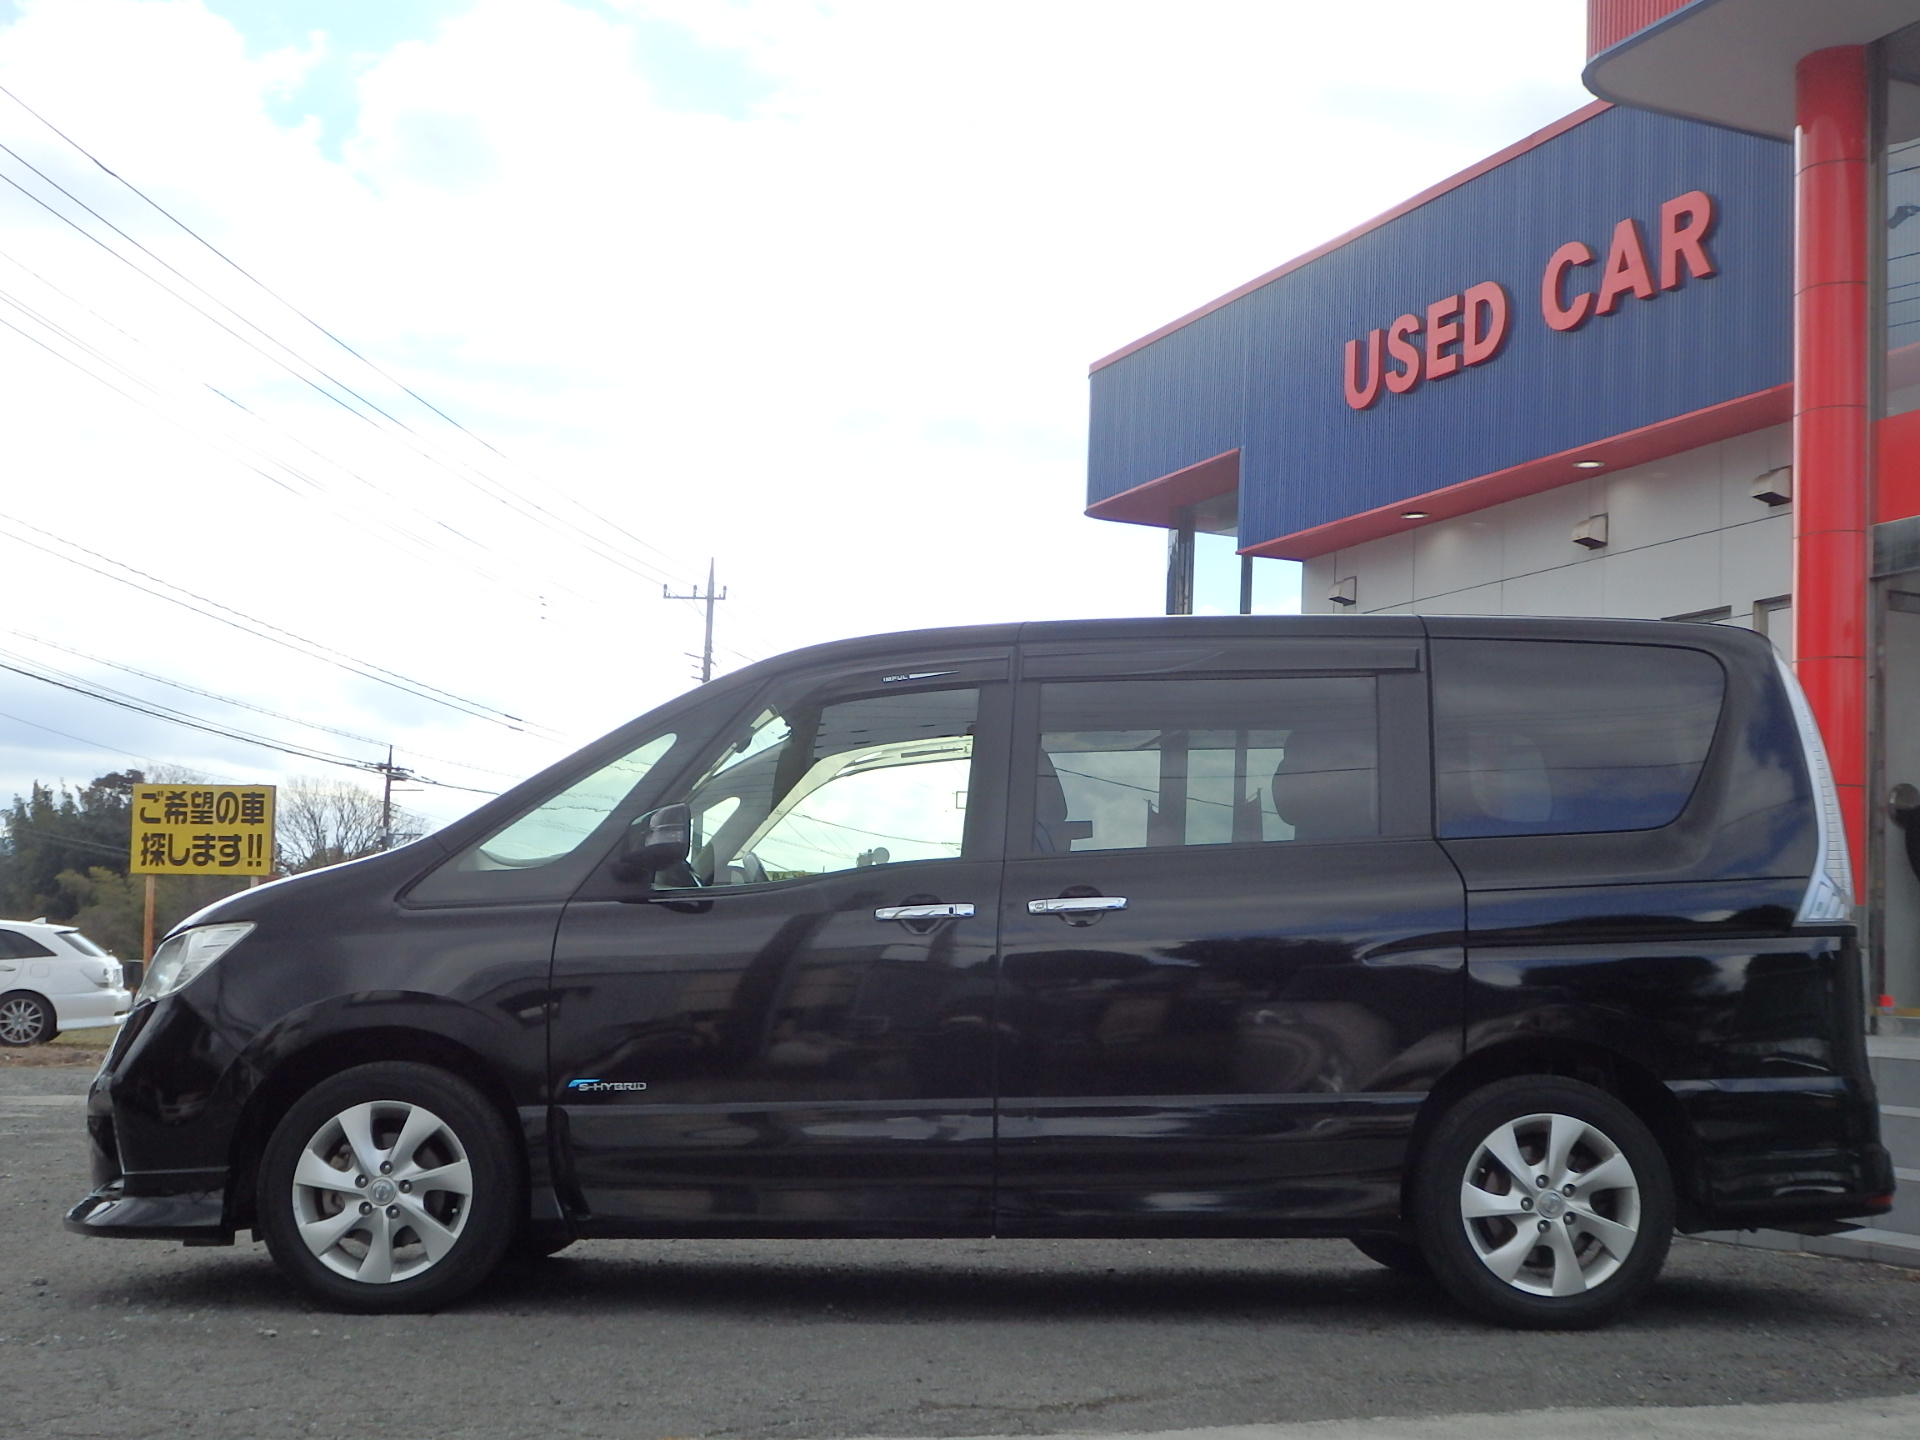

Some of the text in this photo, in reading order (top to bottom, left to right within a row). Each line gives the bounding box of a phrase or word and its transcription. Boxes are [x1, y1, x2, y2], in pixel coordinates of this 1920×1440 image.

[1344, 190, 1716, 410] USED CAR
[140, 790, 265, 826] ご希望の車
[578, 1082, 647, 1092] S-HYBRID
